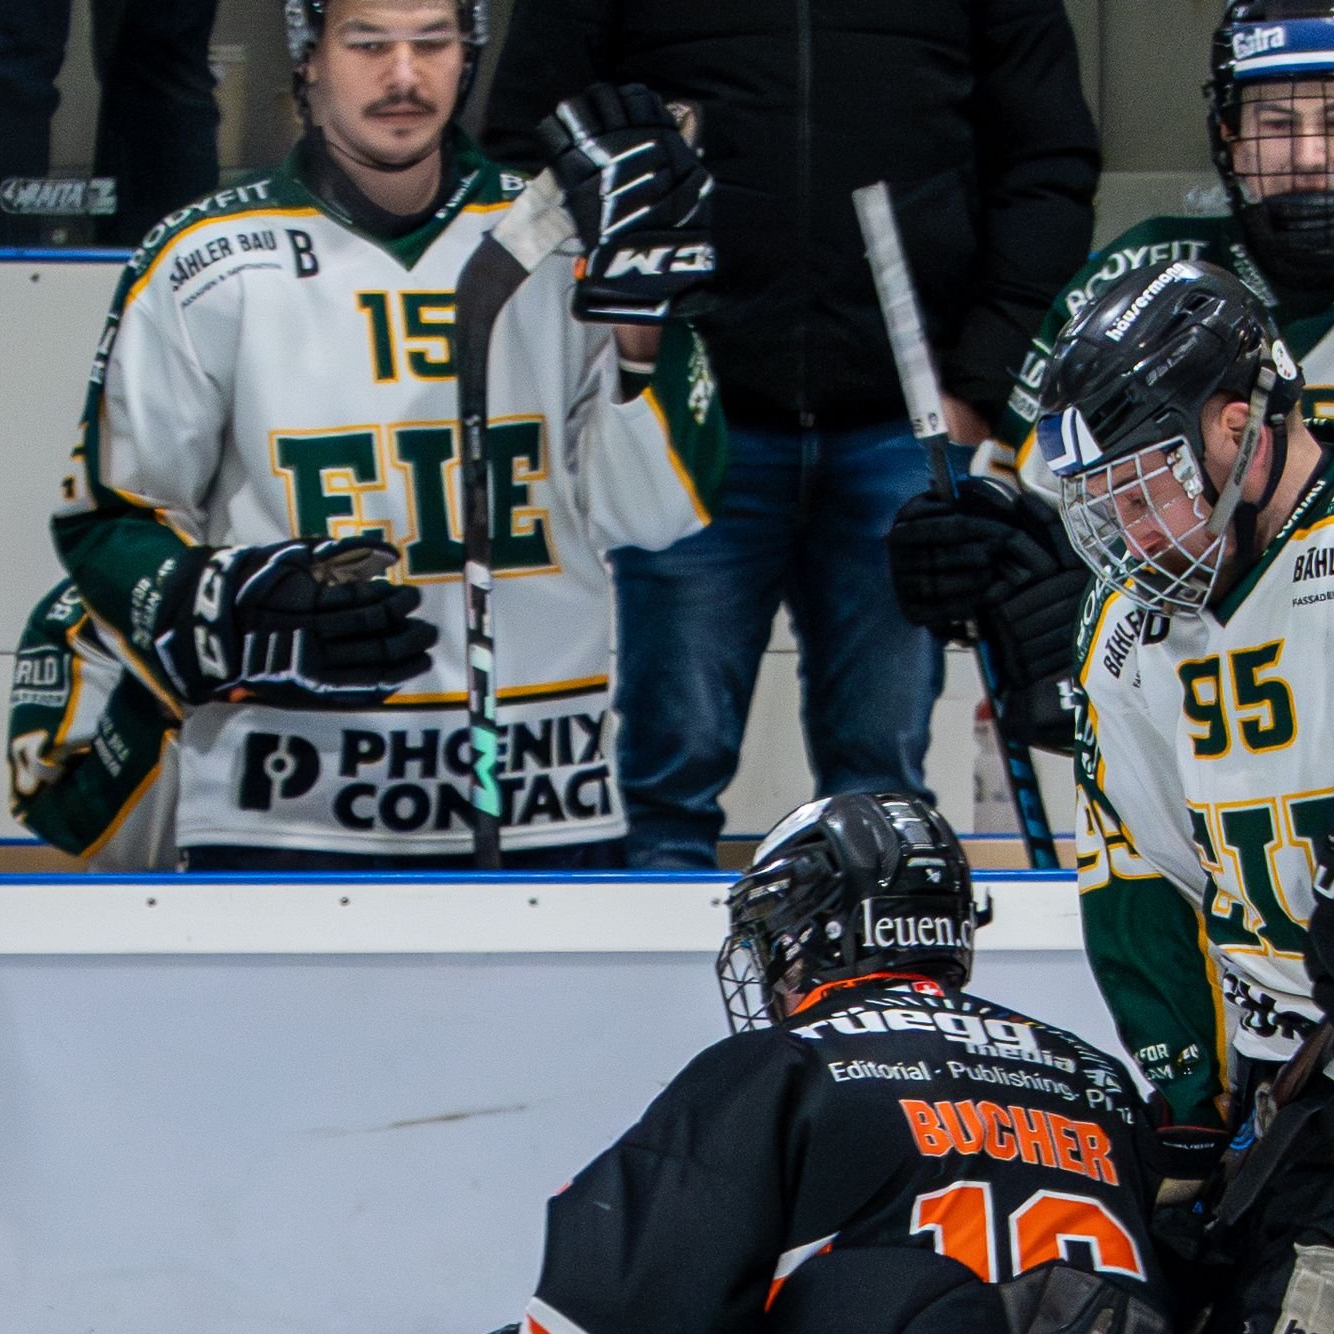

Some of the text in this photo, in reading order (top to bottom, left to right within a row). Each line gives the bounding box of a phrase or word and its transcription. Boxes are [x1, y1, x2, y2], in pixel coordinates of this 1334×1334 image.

[238, 230, 278, 252] BAU
[284, 229, 319, 279] B
[1105, 261, 1190, 342] häusermann
[353, 289, 458, 384] 15
[270, 413, 561, 585] EIE
[1179, 639, 1300, 760] 95
[789, 1006, 1040, 1044] rüegg
[828, 1059, 1073, 1102] Editorial Publishing
[966, 1040, 1079, 1076] media
[898, 1099, 1120, 1187] BUCHER
